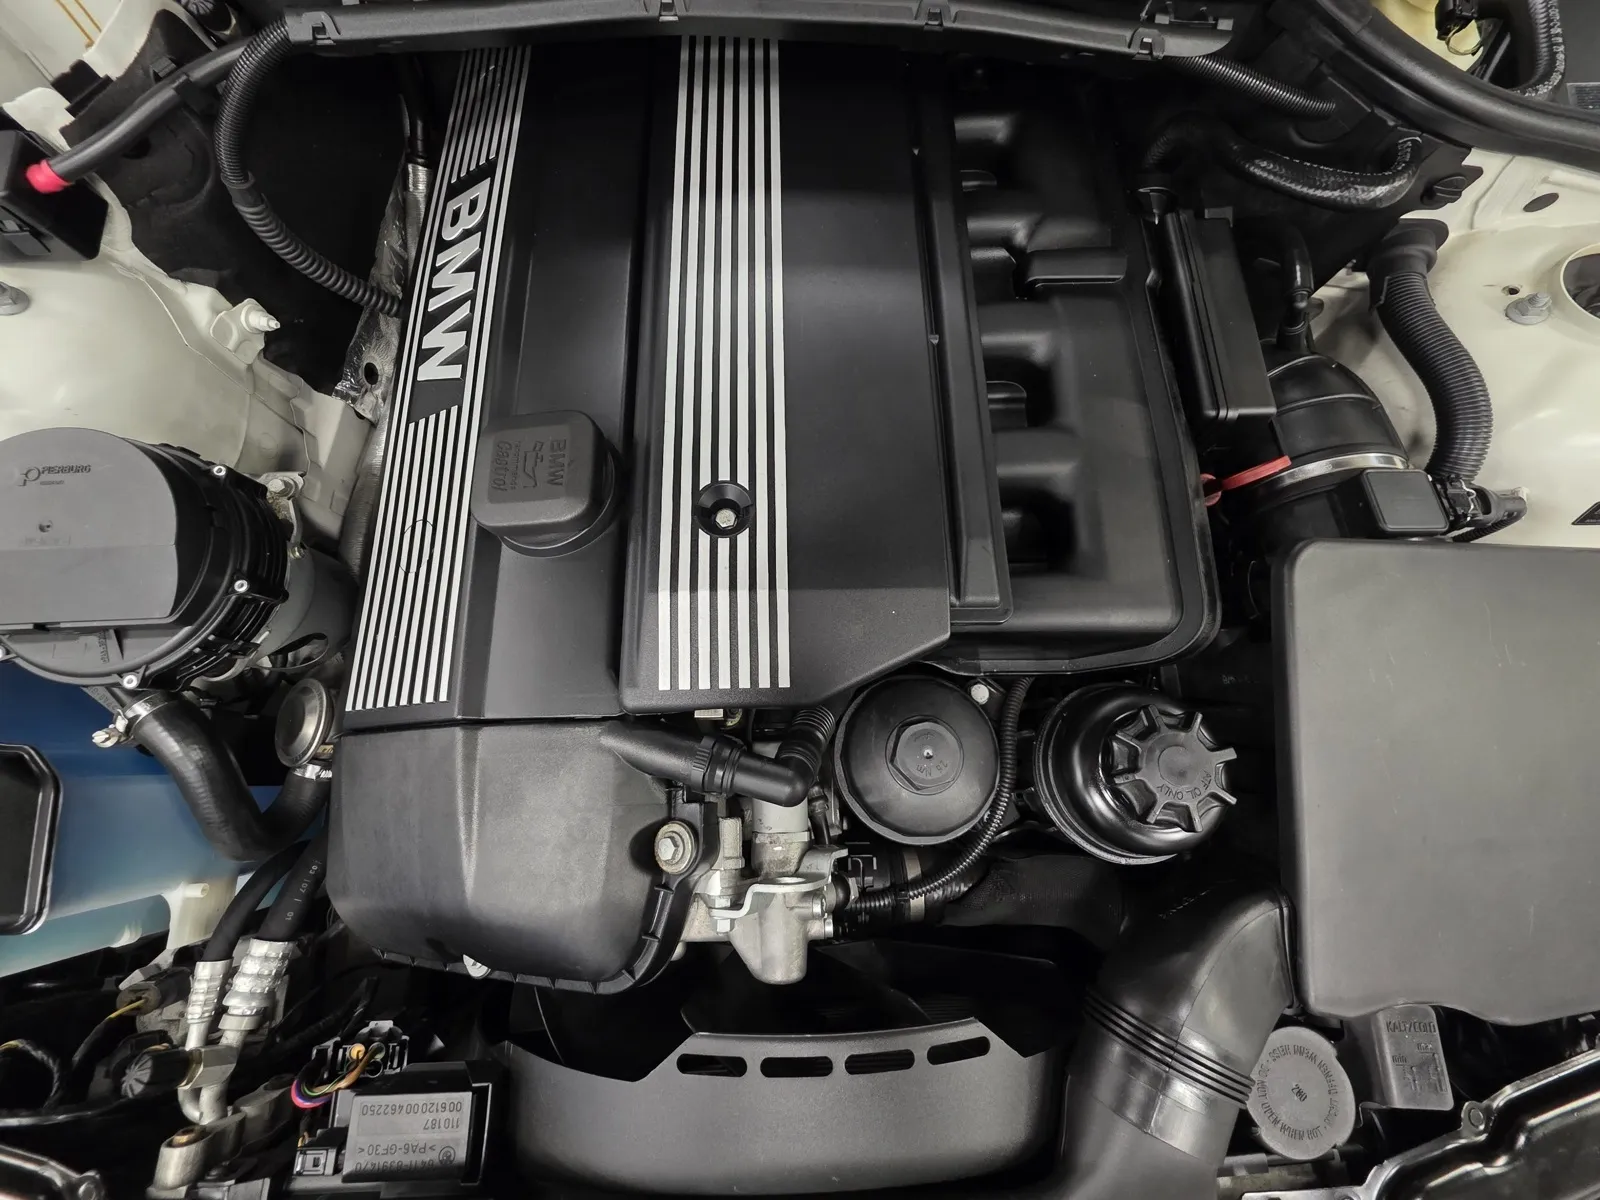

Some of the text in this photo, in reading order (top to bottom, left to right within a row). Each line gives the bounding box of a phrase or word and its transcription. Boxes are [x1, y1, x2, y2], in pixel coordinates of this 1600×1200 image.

[417, 177, 492, 381] BMW
[41, 464, 92, 475] PIERBURG
[491, 440, 512, 492] Castrol
[547, 439, 567, 487] BMW
[1156, 769, 1212, 800] ATF OIL ONLY
[422, 1118, 460, 1130] 110187
